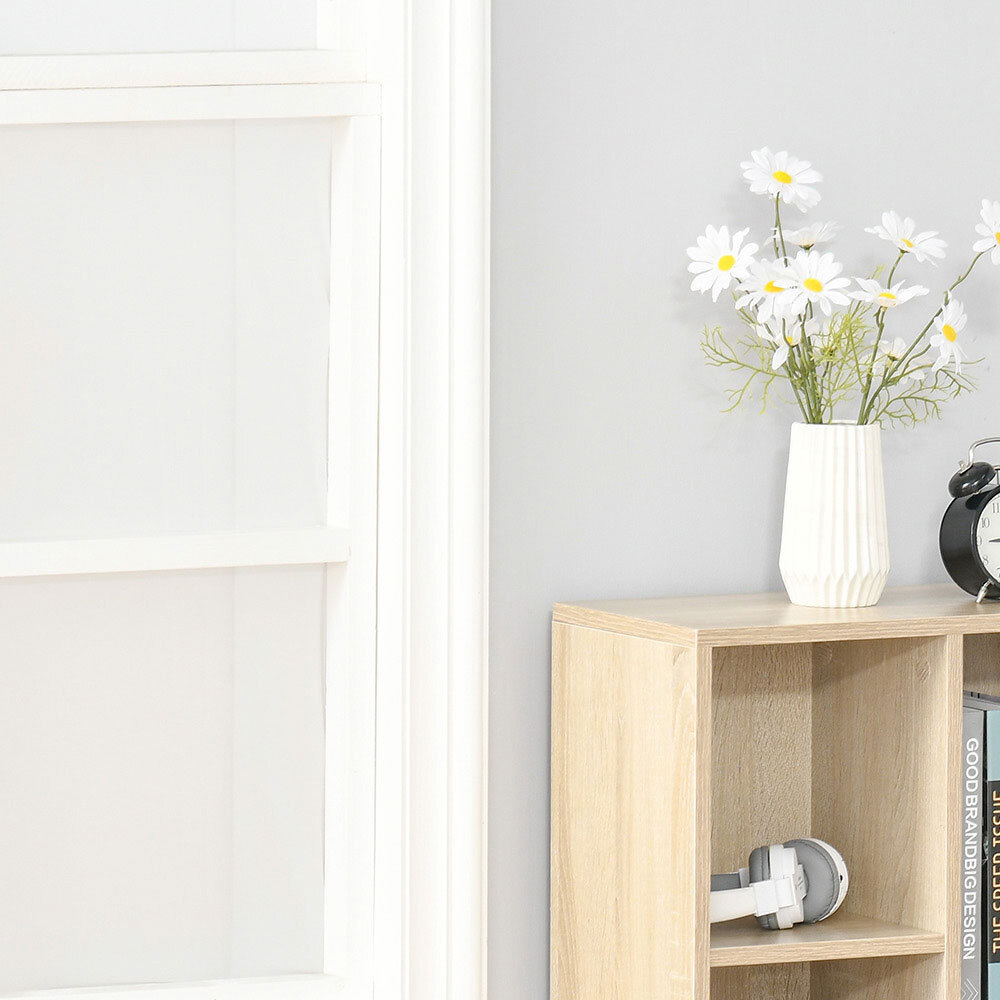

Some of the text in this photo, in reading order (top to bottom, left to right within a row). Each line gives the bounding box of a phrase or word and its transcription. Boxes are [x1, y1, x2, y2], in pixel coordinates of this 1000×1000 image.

[992, 502, 1000, 513] 11
[981, 517, 990, 528] 10
[983, 554, 989, 565] 8
[963, 891, 977, 960] DESIGN
